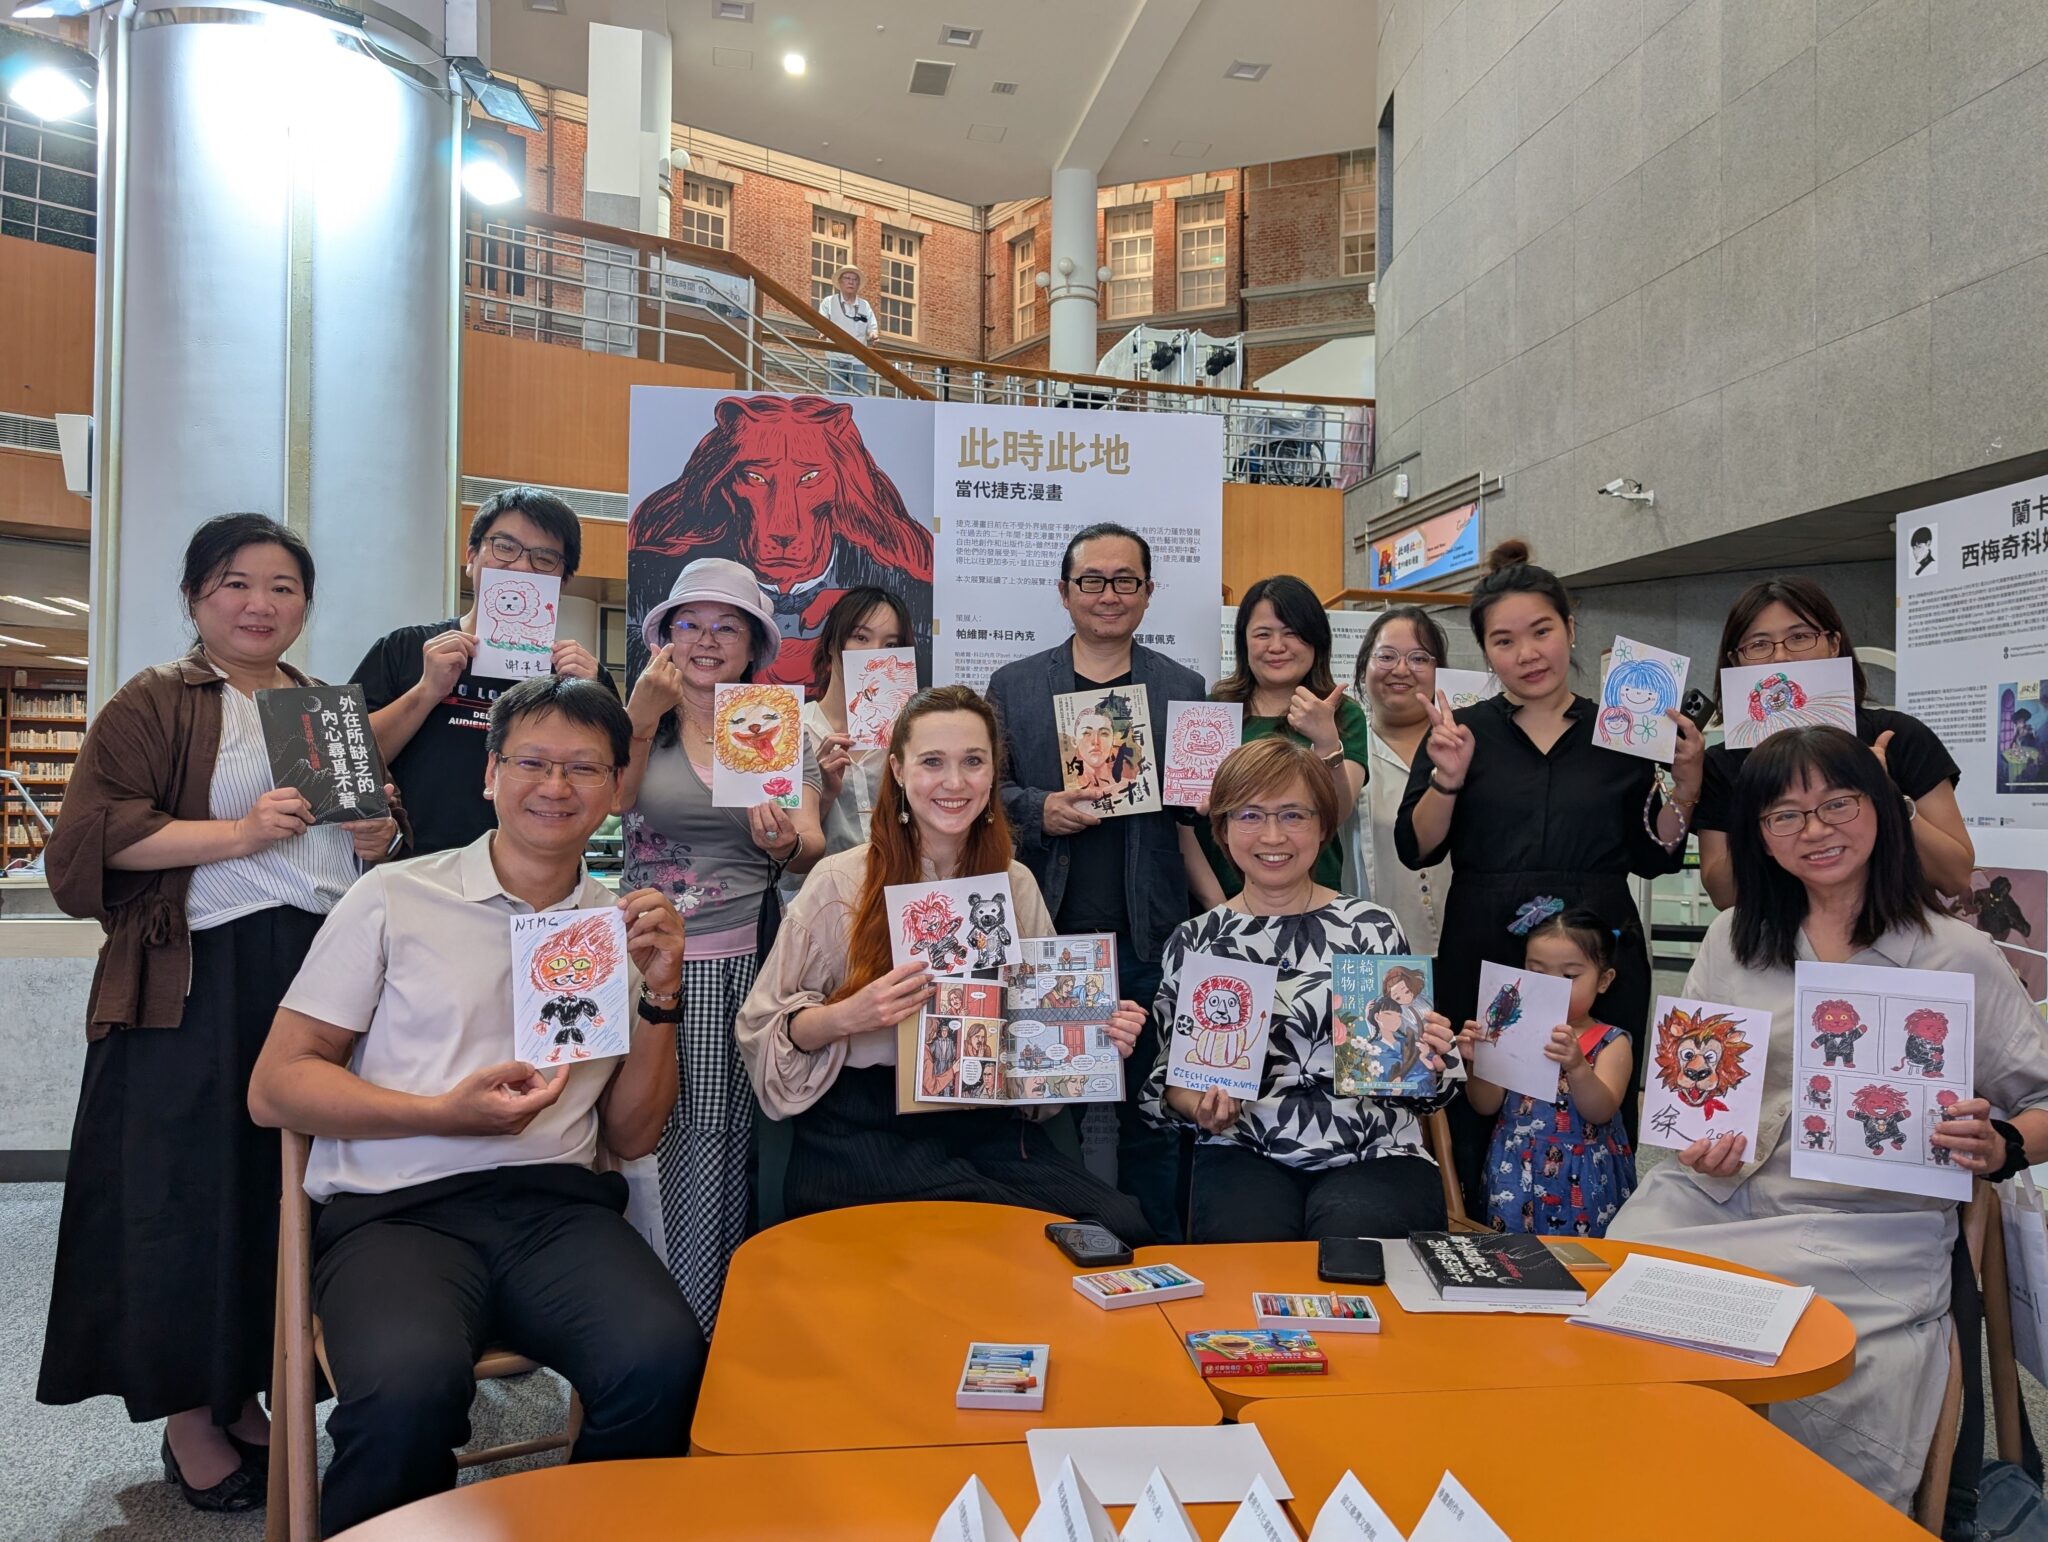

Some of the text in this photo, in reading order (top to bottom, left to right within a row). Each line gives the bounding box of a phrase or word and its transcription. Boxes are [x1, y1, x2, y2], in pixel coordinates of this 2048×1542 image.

[957, 426, 1131, 475] 此時此地
[955, 480, 1063, 502] 當代捷克漫畫
[448, 717, 493, 732] AUDIENC
[473, 711, 491, 720] DEL
[339, 695, 375, 793] 外在所缺乏的
[321, 710, 356, 809] 內心尋覓不著
[1173, 1067, 1202, 1080] CZECH
[1204, 1074, 1232, 1087] CENTRE
[1185, 1080, 1210, 1091] TAIPE
[1651, 1104, 1697, 1143] 徐
